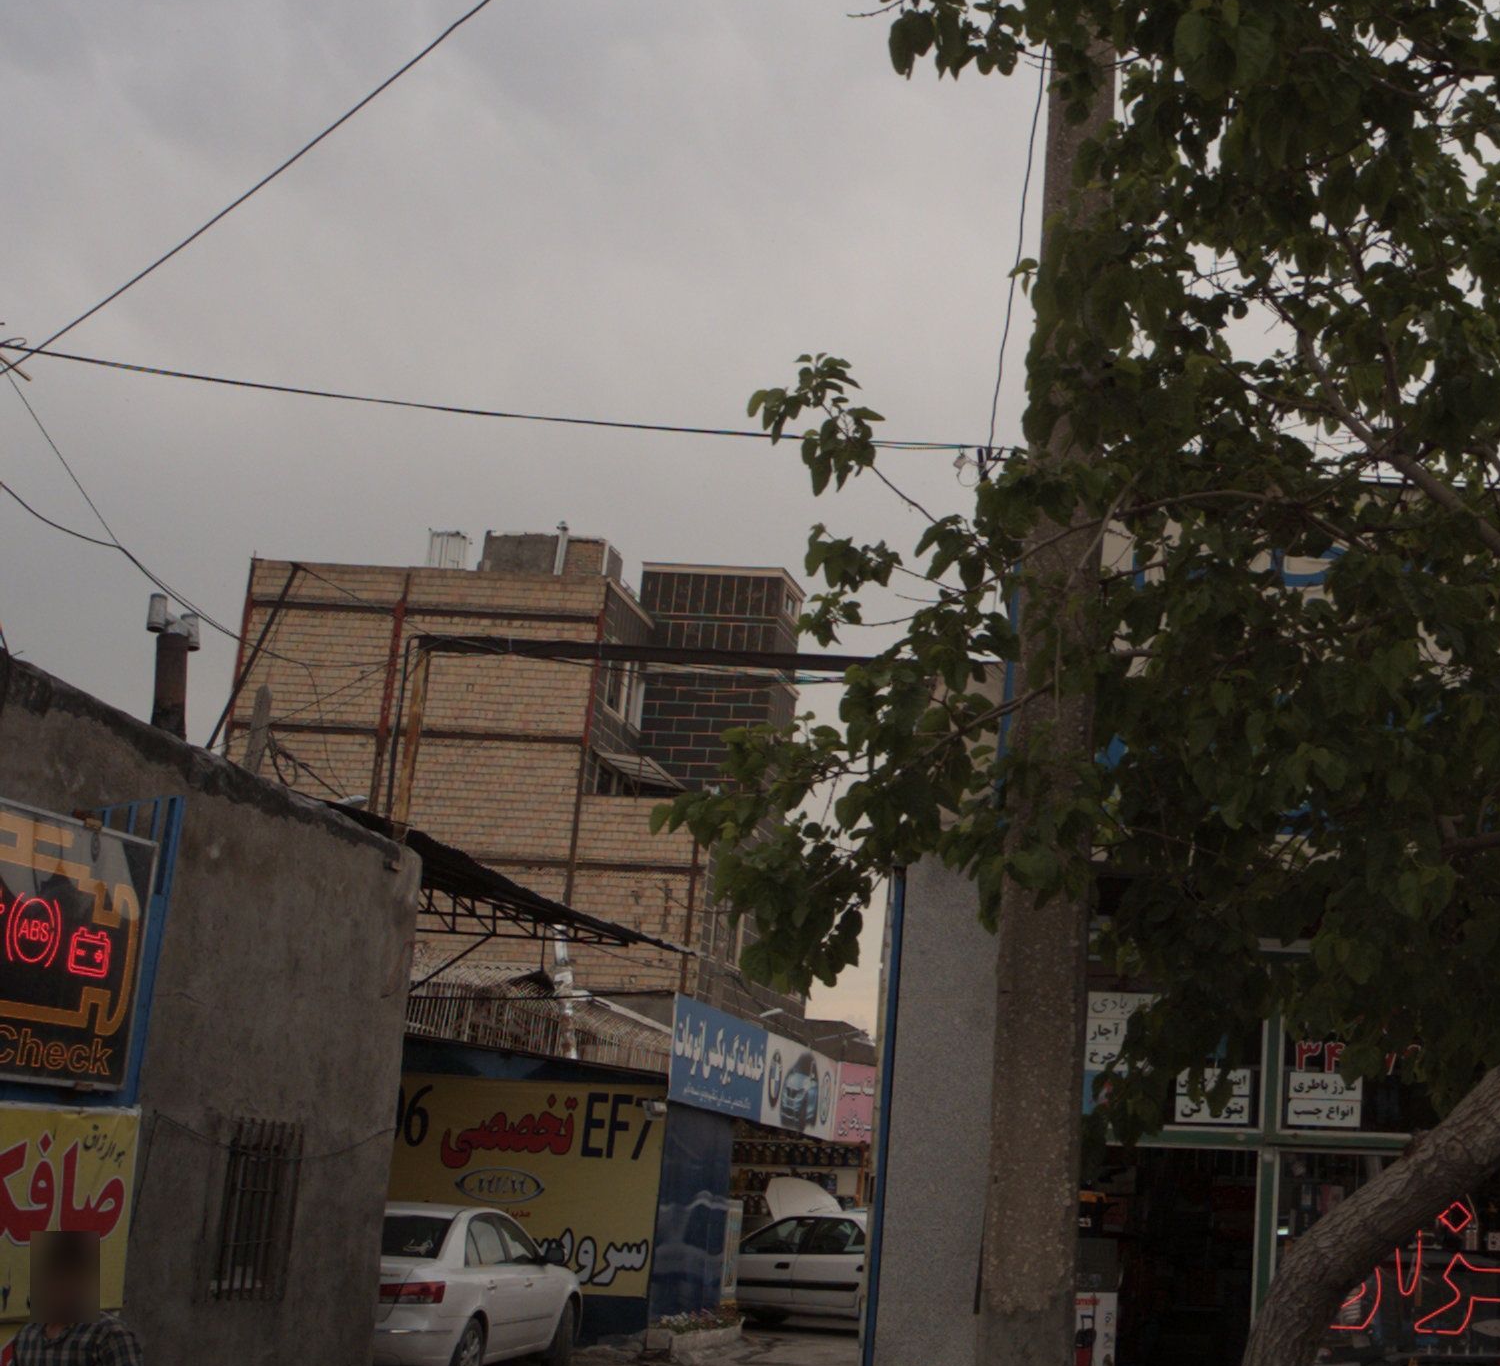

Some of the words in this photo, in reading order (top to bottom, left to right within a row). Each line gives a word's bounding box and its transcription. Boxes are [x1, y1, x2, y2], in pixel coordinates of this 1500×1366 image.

[18, 919, 50, 943] ABS
[441, 1093, 575, 1169] تخصصی
[581, 1091, 654, 1161] EF7
[1326, 1106, 1354, 1121] انواع
